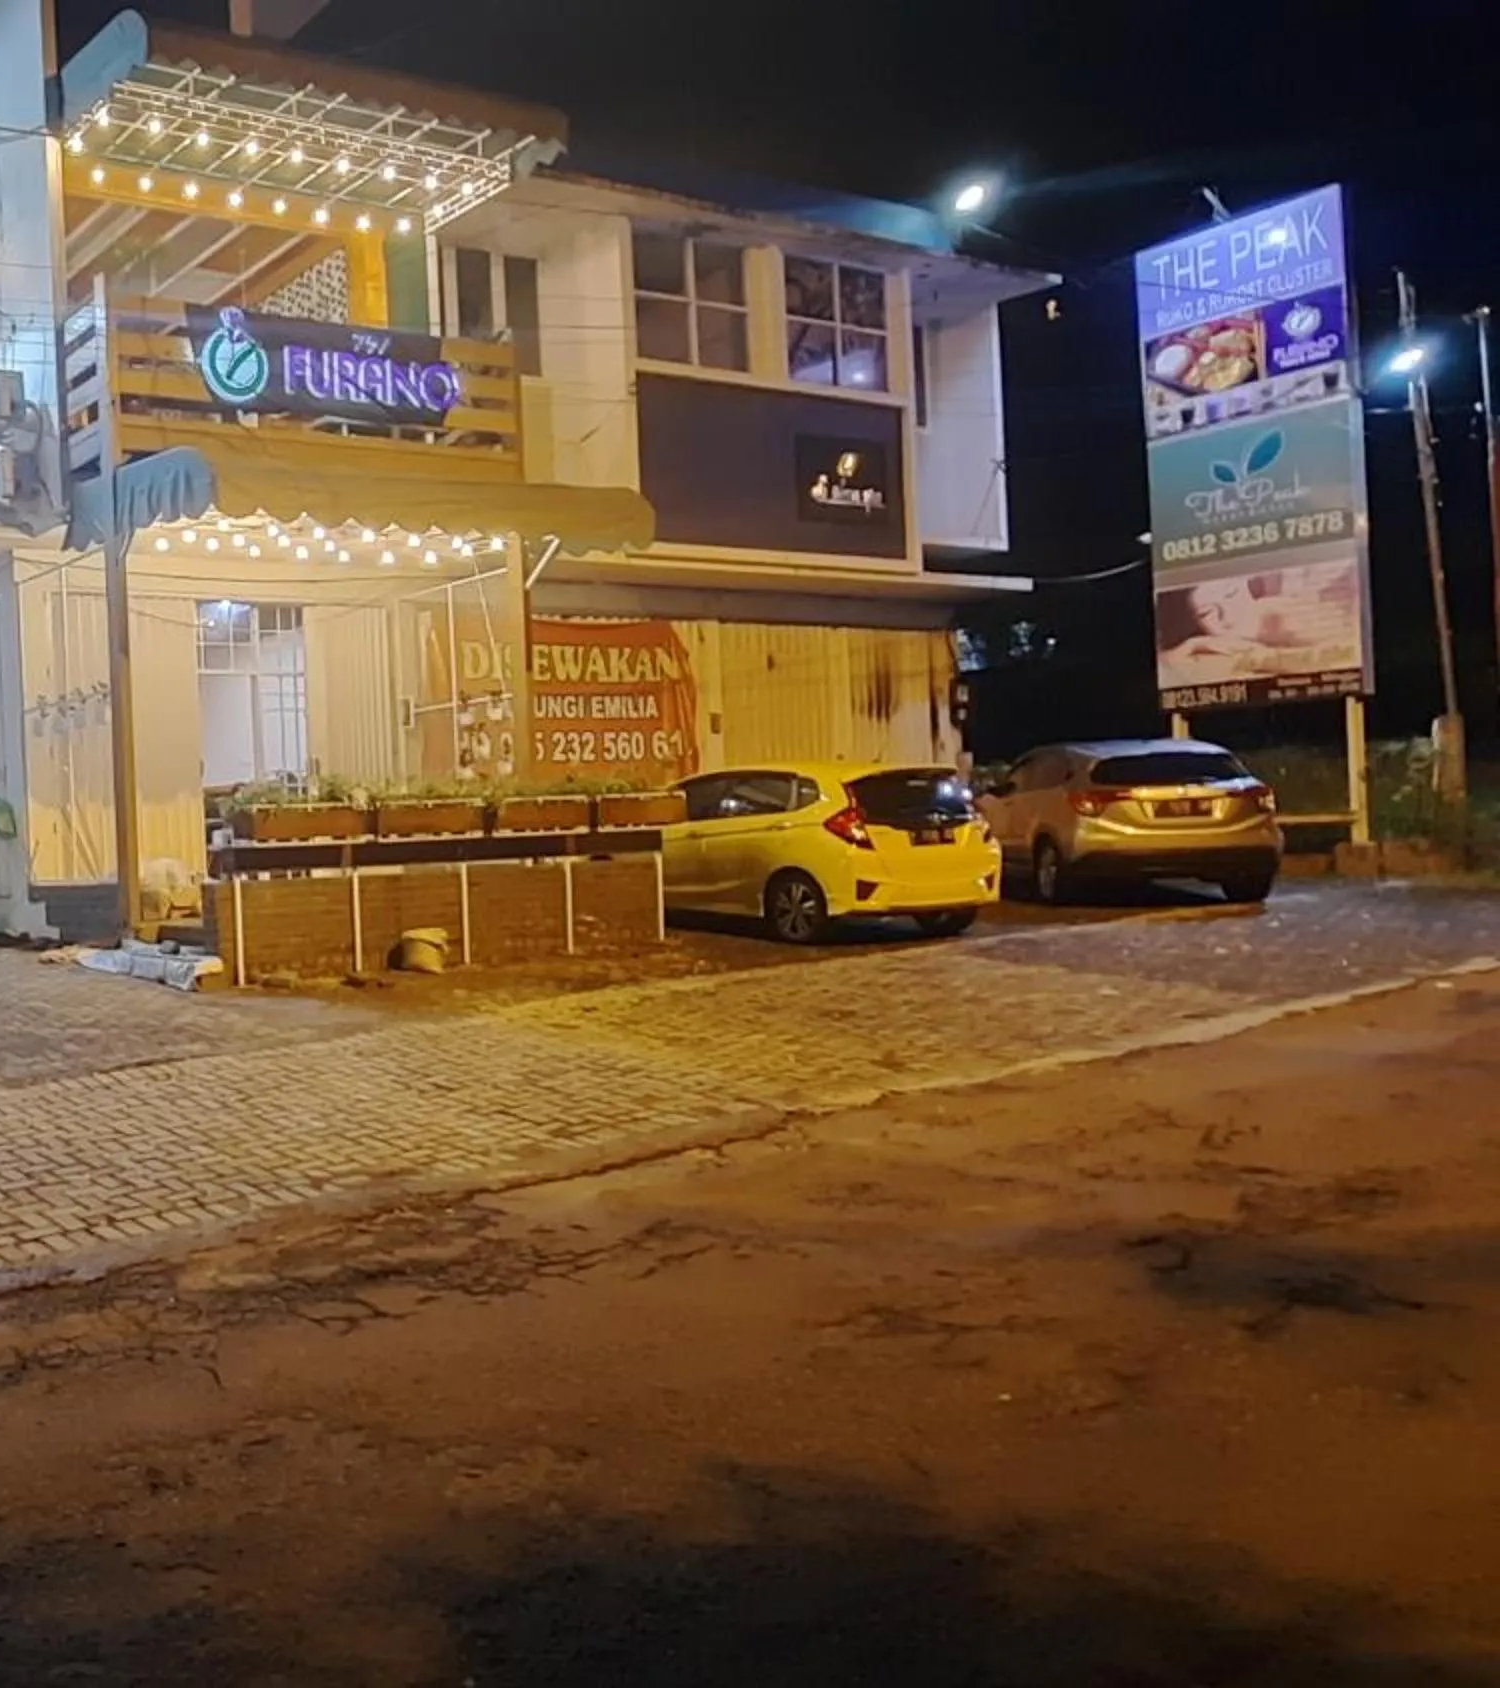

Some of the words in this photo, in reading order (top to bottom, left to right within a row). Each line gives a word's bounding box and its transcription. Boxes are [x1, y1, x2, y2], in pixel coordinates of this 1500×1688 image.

[1152, 239, 1220, 300] THE
[1229, 202, 1329, 280] PEAK
[282, 344, 462, 413] FURANO
[1161, 532, 1218, 562] 0812
[1220, 521, 1281, 552] 3236
[1284, 510, 1345, 541] 7878
[591, 694, 660, 719] EMILIA
[552, 731, 596, 761] 232
[603, 731, 645, 761] 560
